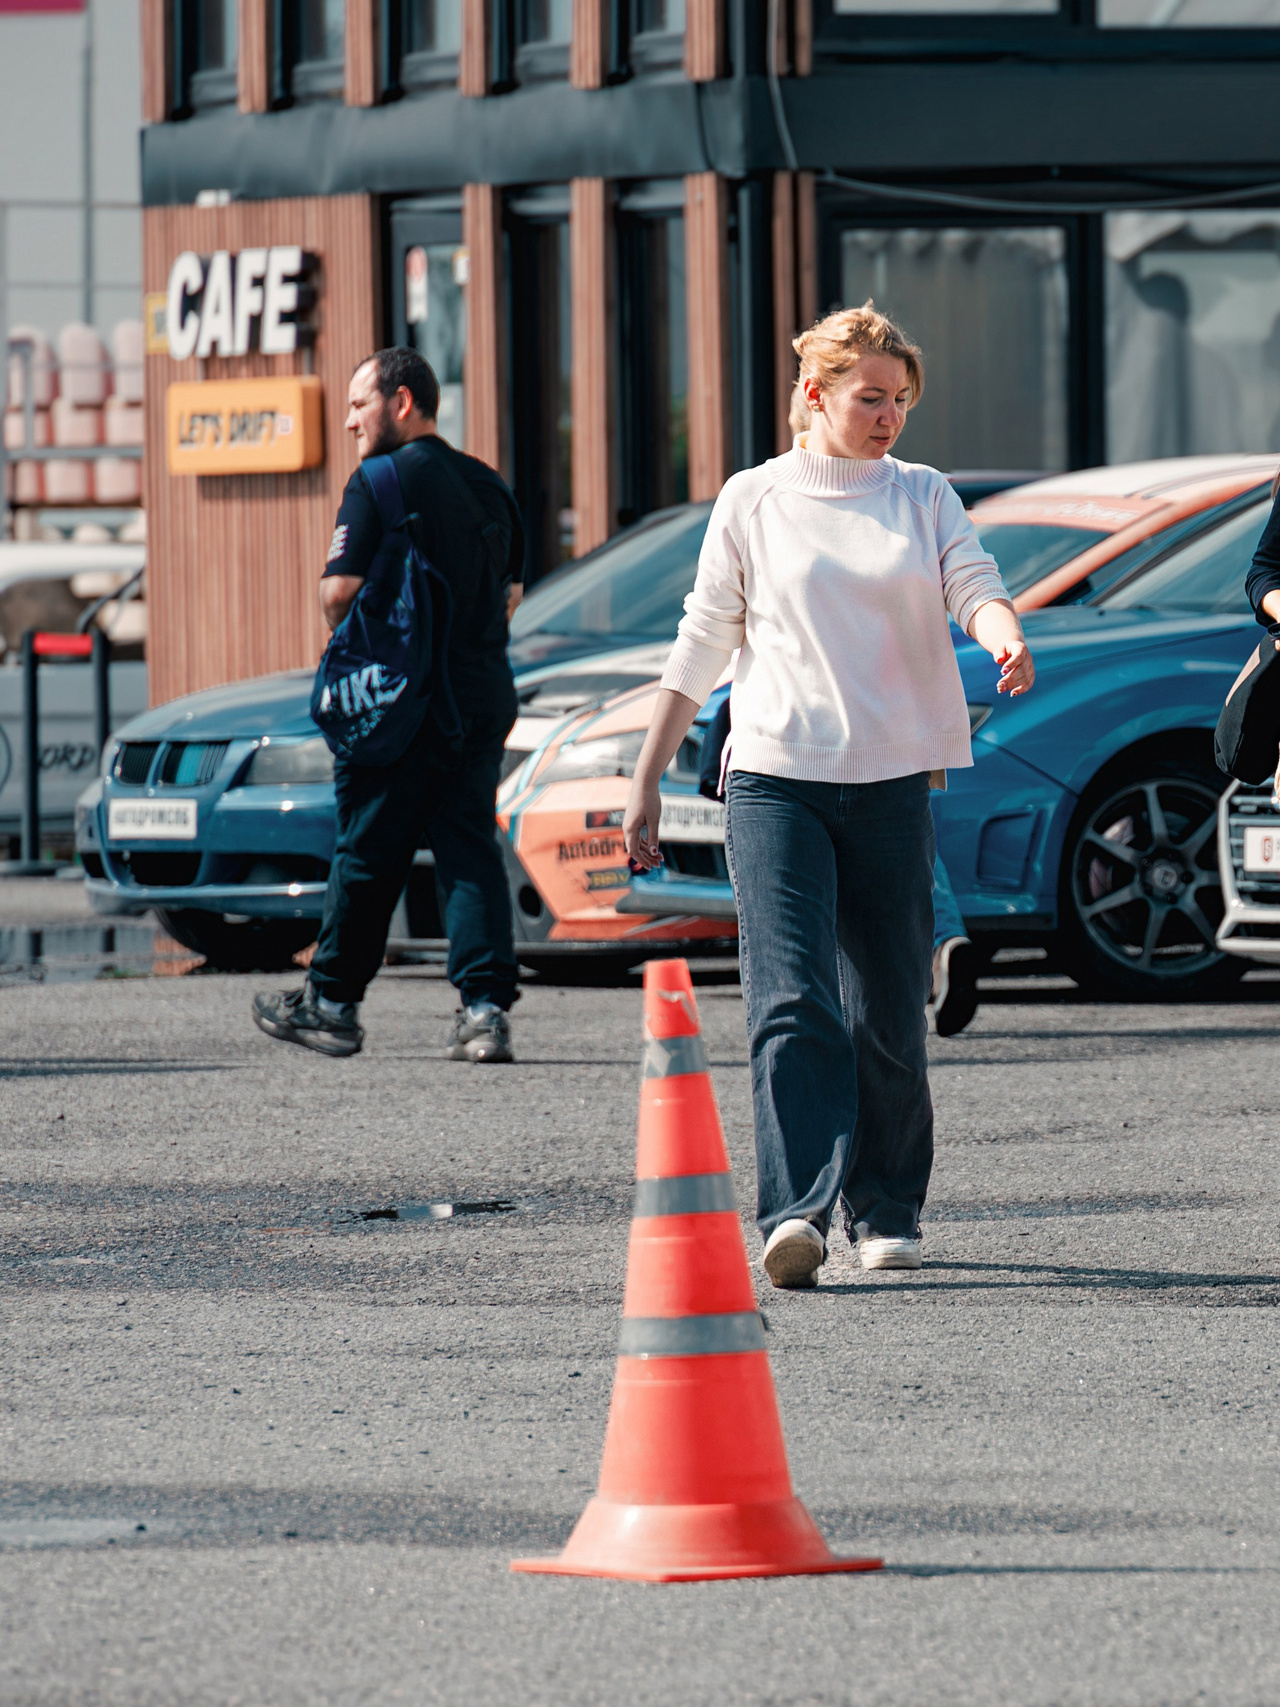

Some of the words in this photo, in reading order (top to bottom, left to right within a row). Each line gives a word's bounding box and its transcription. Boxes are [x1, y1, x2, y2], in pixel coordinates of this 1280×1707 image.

[167, 245, 301, 361] CAFE
[229, 410, 278, 445] DRIFT
[559, 838, 629, 861] Autodr
